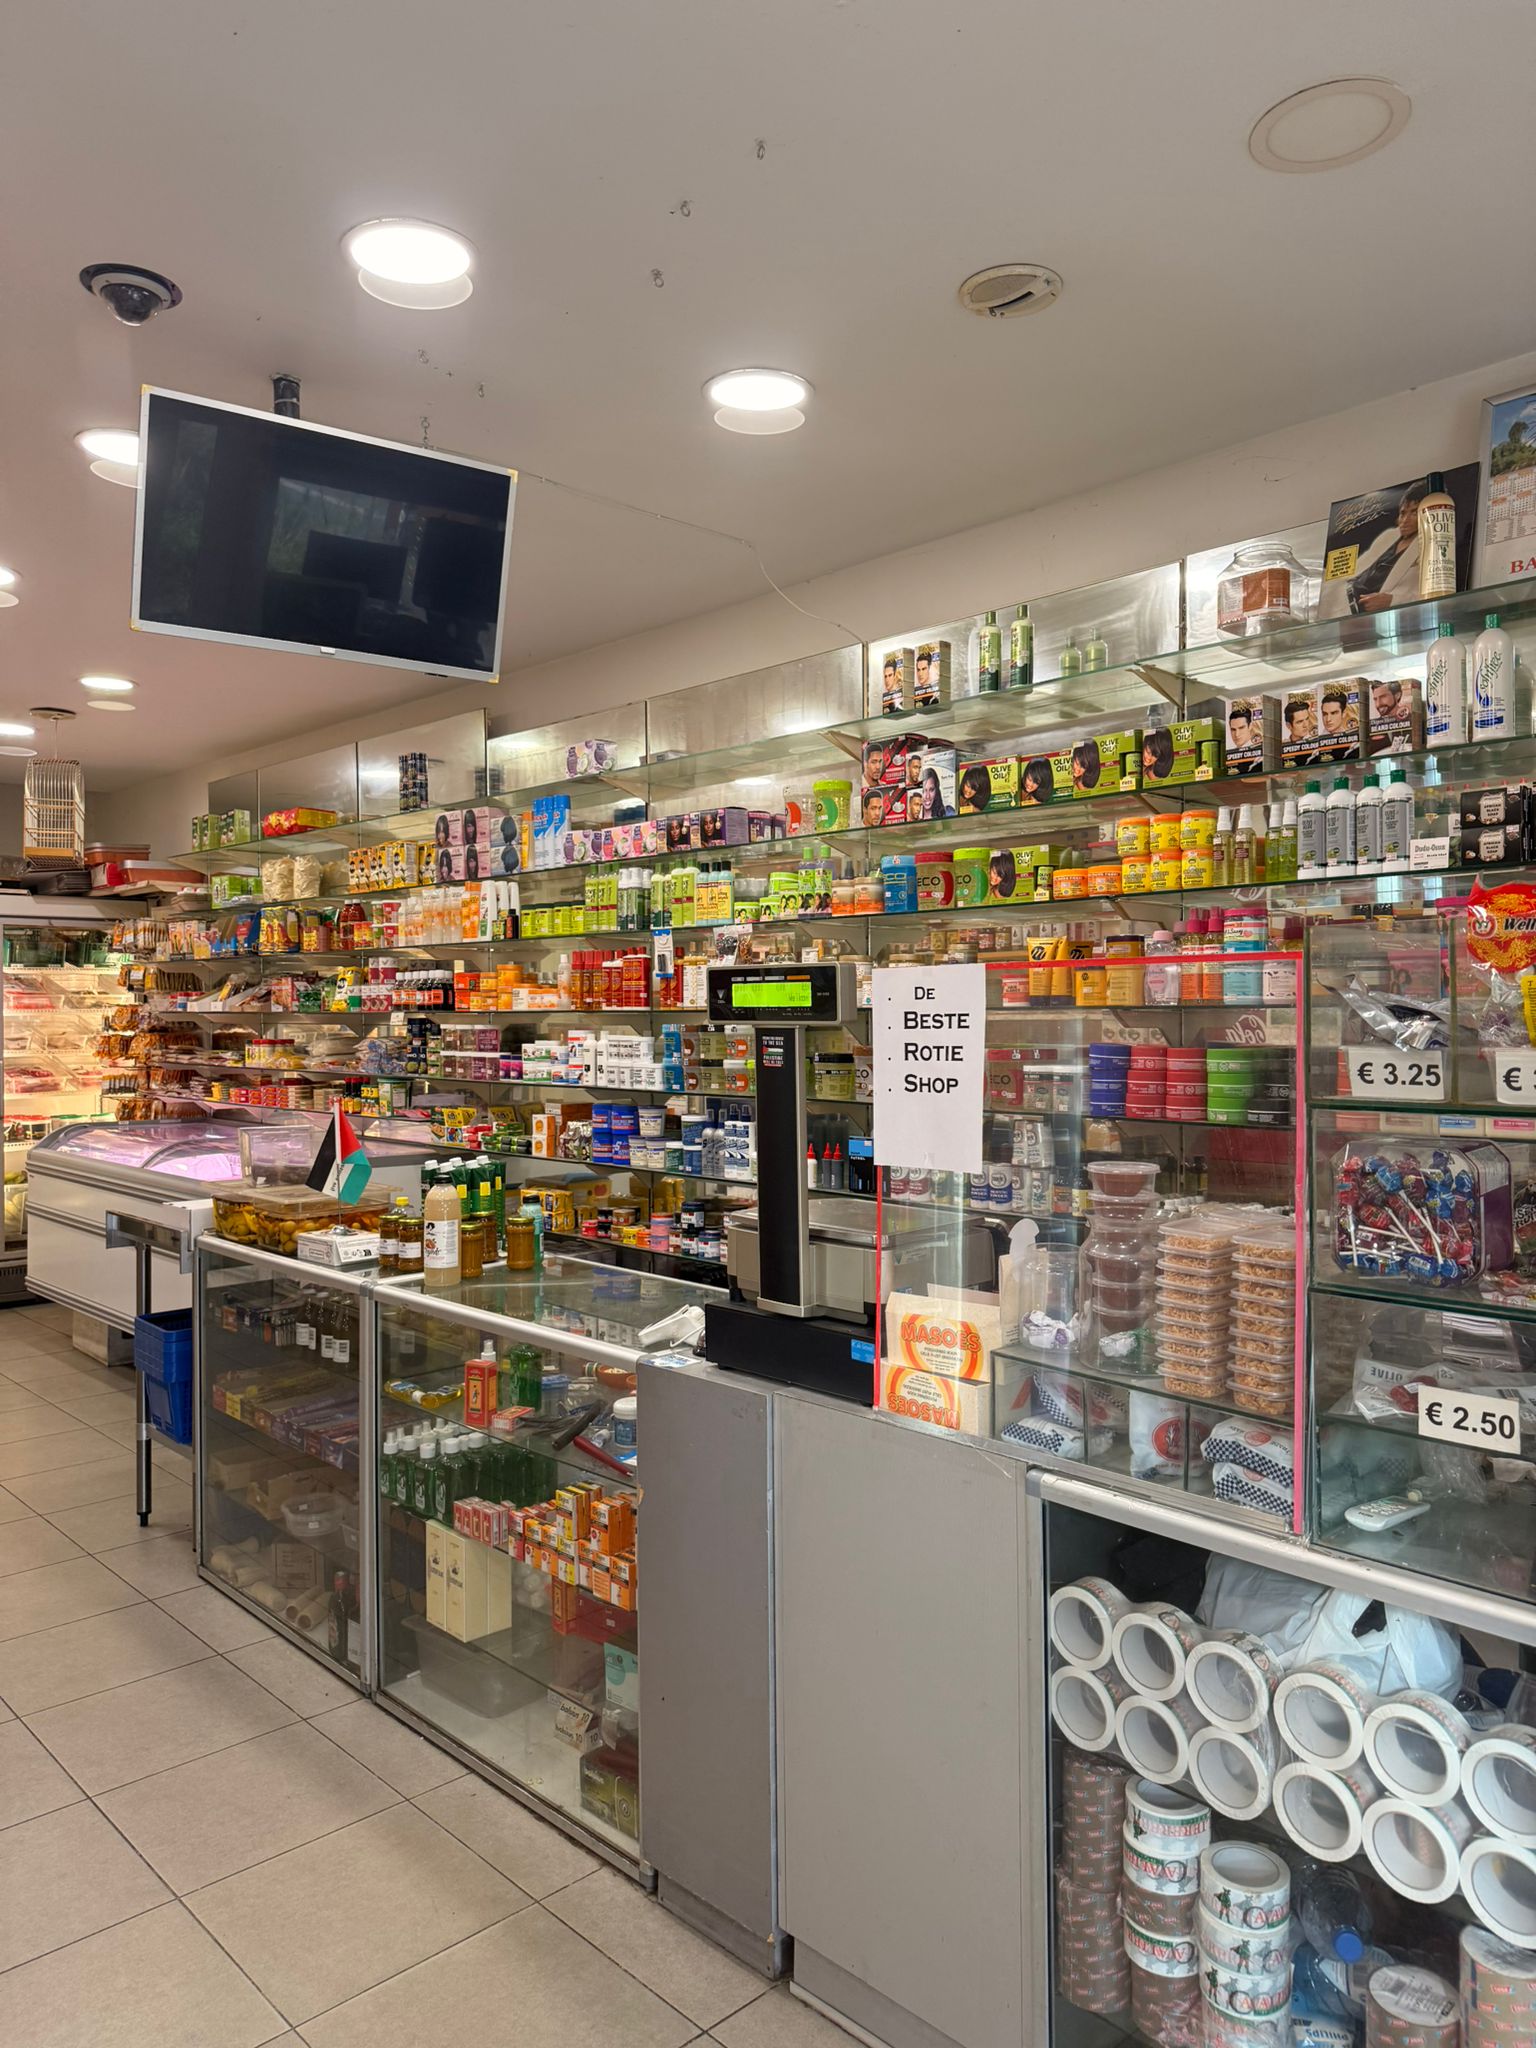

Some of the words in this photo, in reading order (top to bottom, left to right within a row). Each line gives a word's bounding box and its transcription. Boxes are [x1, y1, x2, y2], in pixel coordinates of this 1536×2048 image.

[1427, 512, 1454, 524] OLIVE
[1174, 726, 1195, 736] OLIVE
[1100, 738, 1119, 747] OLIVE
[1054, 758, 1072, 766] OLIV
[991, 765, 1011, 774] OLIVE
[1504, 918, 1536, 931] Well
[1357, 1062, 1375, 1085] €
[1384, 1063, 1441, 1087] 3.25
[1502, 1067, 1522, 1092] €
[901, 1322, 980, 1353] MASOES
[888, 1392, 960, 1431] MASOES
[1425, 1402, 1443, 1426] €
[1453, 1406, 1515, 1439] 2.50
